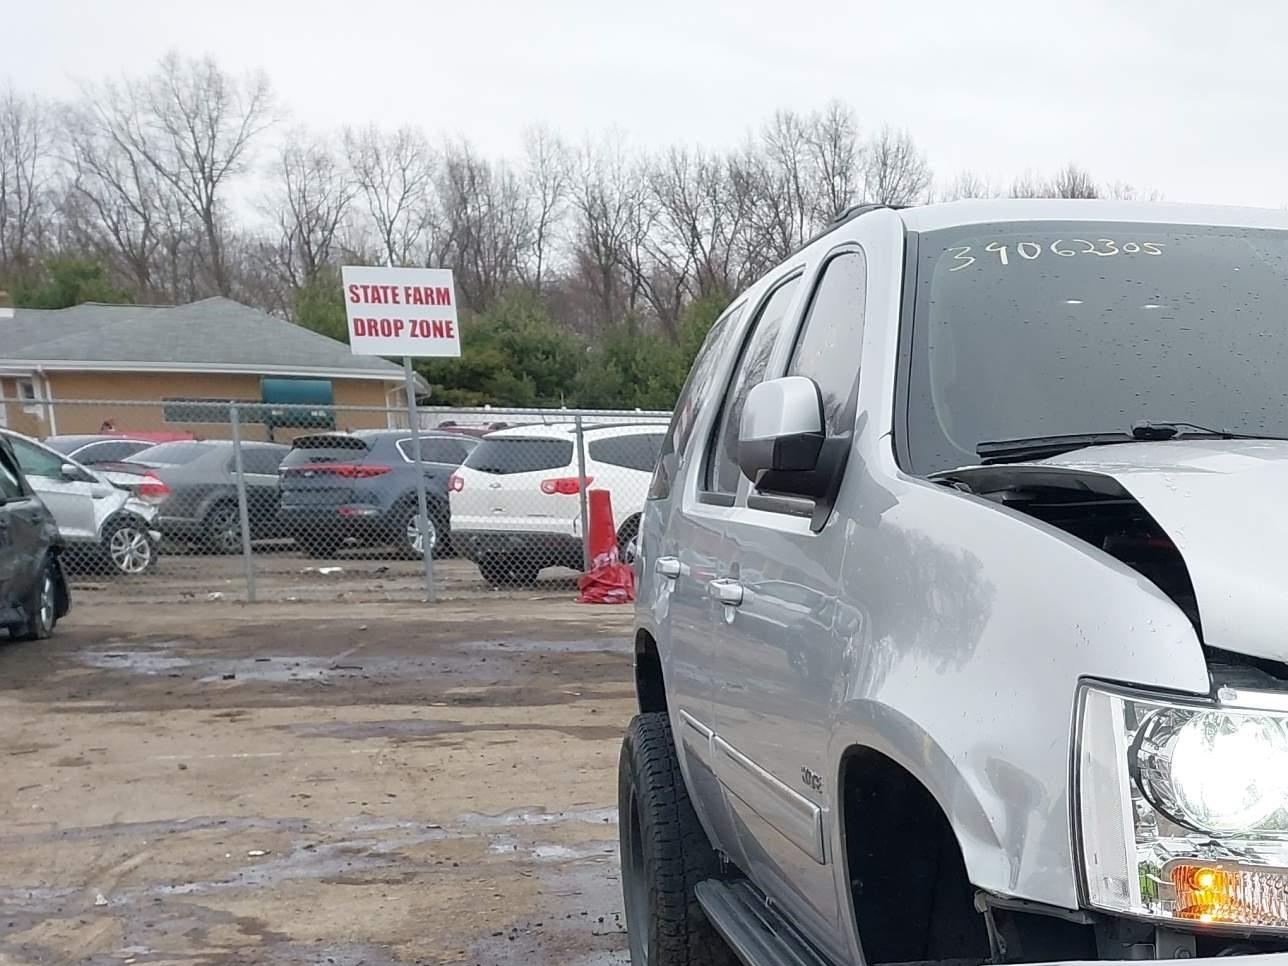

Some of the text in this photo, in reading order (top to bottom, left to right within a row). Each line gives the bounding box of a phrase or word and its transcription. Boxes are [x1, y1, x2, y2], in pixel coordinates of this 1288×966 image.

[947, 238, 1166, 271] 39062305
[349, 284, 451, 306] STATE FARM
[353, 317, 455, 339] DROP ZONE
